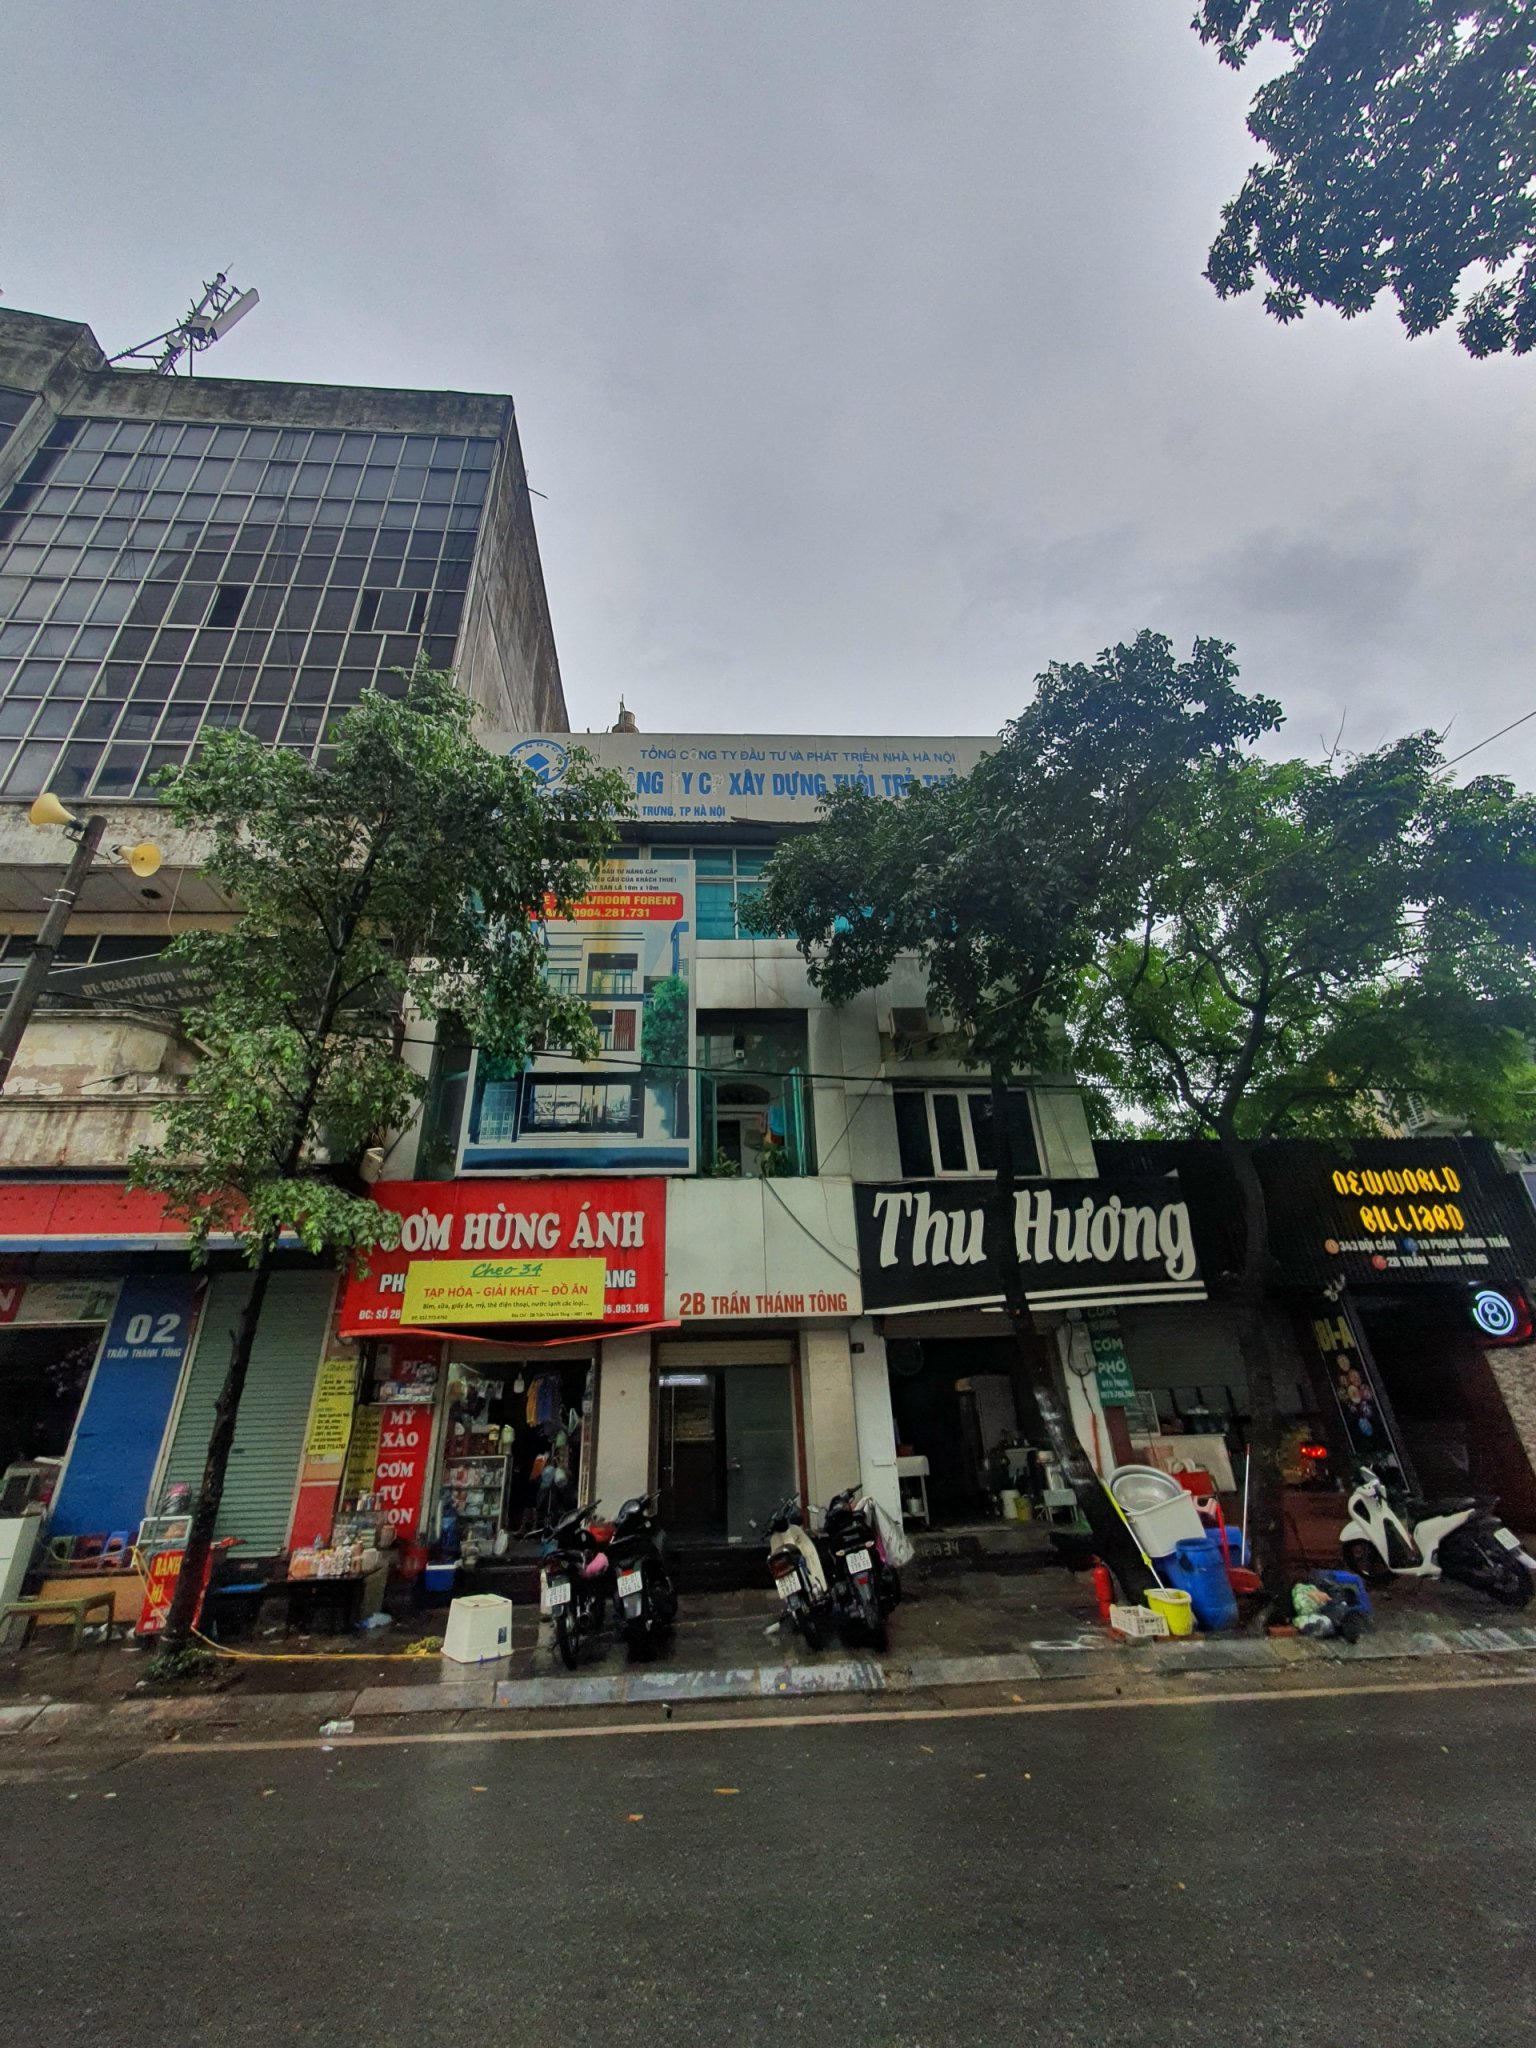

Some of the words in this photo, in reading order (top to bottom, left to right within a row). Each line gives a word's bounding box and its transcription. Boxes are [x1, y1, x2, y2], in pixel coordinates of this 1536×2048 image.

[640, 744, 676, 760] TỔNG
[721, 750, 737, 760] TY
[740, 747, 766, 761] ĐẦU
[769, 750, 787, 761] TƯ
[788, 749, 804, 762] VÀ
[807, 749, 838, 762] PHÁT
[842, 747, 879, 762] TRIỂN
[884, 749, 910, 762] NHÀ
[913, 749, 931, 762] HÀ
[934, 750, 956, 764] NỘI
[729, 769, 766, 796] XÂY
[772, 771, 827, 800] DỰNG
[680, 806, 692, 816] TP
[693, 805, 707, 816] HÀ
[709, 806, 726, 818] NỘI
[634, 895, 677, 905] FORENT
[1332, 1166, 1461, 1196] NEWWORLD
[380, 1207, 453, 1252] ƠM
[460, 1202, 561, 1251] HÙNG
[569, 1201, 646, 1250] ÁNH
[1359, 1203, 1465, 1233] BILLIARD
[872, 1189, 987, 1268] Thu
[1012, 1188, 1197, 1281] Hương
[379, 1273, 407, 1294] PH
[604, 1269, 636, 1289] ANG
[424, 1287, 445, 1300] TẠP
[448, 1285, 473, 1297] HÓA
[483, 1283, 506, 1297] GIẢI
[510, 1283, 539, 1297] KHÁT
[551, 1282, 568, 1296] ĐỒ
[572, 1284, 588, 1295] ĂN
[376, 1306, 390, 1320] SỐ
[678, 1292, 706, 1316] 2B
[710, 1291, 751, 1315] TRẦN
[755, 1290, 805, 1313] THÁNH
[809, 1292, 848, 1313] TÔNG
[124, 1313, 182, 1345] 02
[1093, 1336, 1124, 1352] CƠM
[1098, 1356, 1127, 1374] PHỞ
[377, 1460, 414, 1478] CƠM
